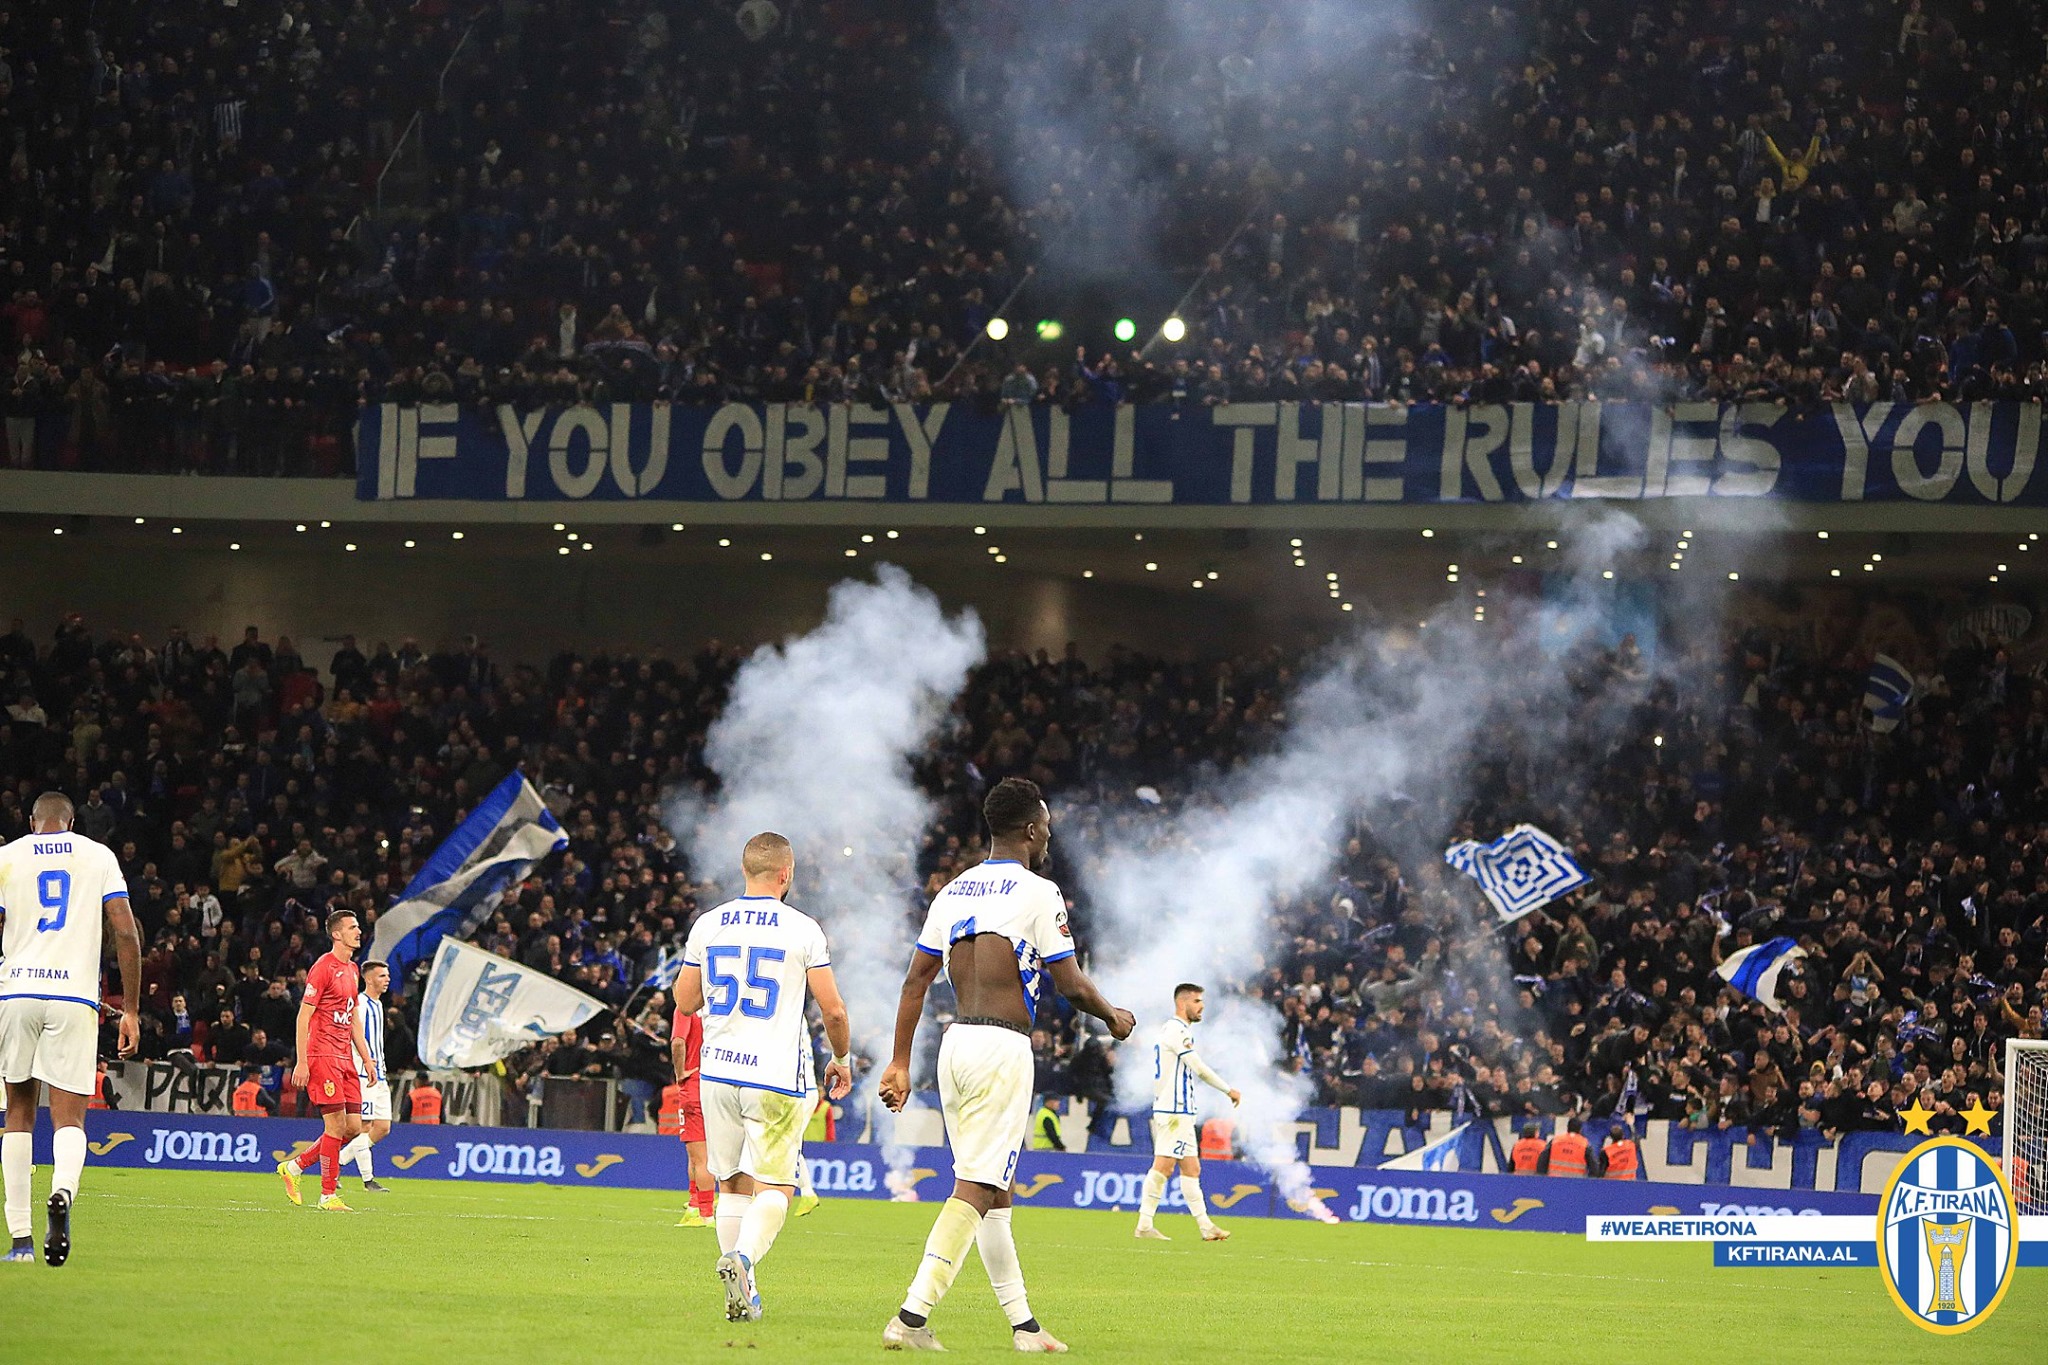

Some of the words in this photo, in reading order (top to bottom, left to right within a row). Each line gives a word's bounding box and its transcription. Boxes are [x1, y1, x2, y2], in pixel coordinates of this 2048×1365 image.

[376, 401, 460, 500] IF
[497, 401, 672, 499] YOU
[702, 401, 951, 500] OBEY
[983, 402, 1174, 504] ALL
[1213, 402, 1408, 504] THE
[1439, 401, 1789, 502] RULES
[1830, 401, 2042, 502] YOU
[36, 869, 71, 933] 9
[720, 910, 779, 927] BATHA
[10, 967, 23, 978] KF
[27, 968, 70, 980] TIRANA
[706, 945, 786, 1021] 55
[714, 1047, 758, 1067] TIRANA
[361, 1101, 374, 1116] 21
[144, 1129, 262, 1164] Joma
[448, 1142, 565, 1177] Joma
[806, 1158, 877, 1192] ma
[1002, 1150, 1017, 1182] 8
[1350, 1184, 1479, 1223] Joma
